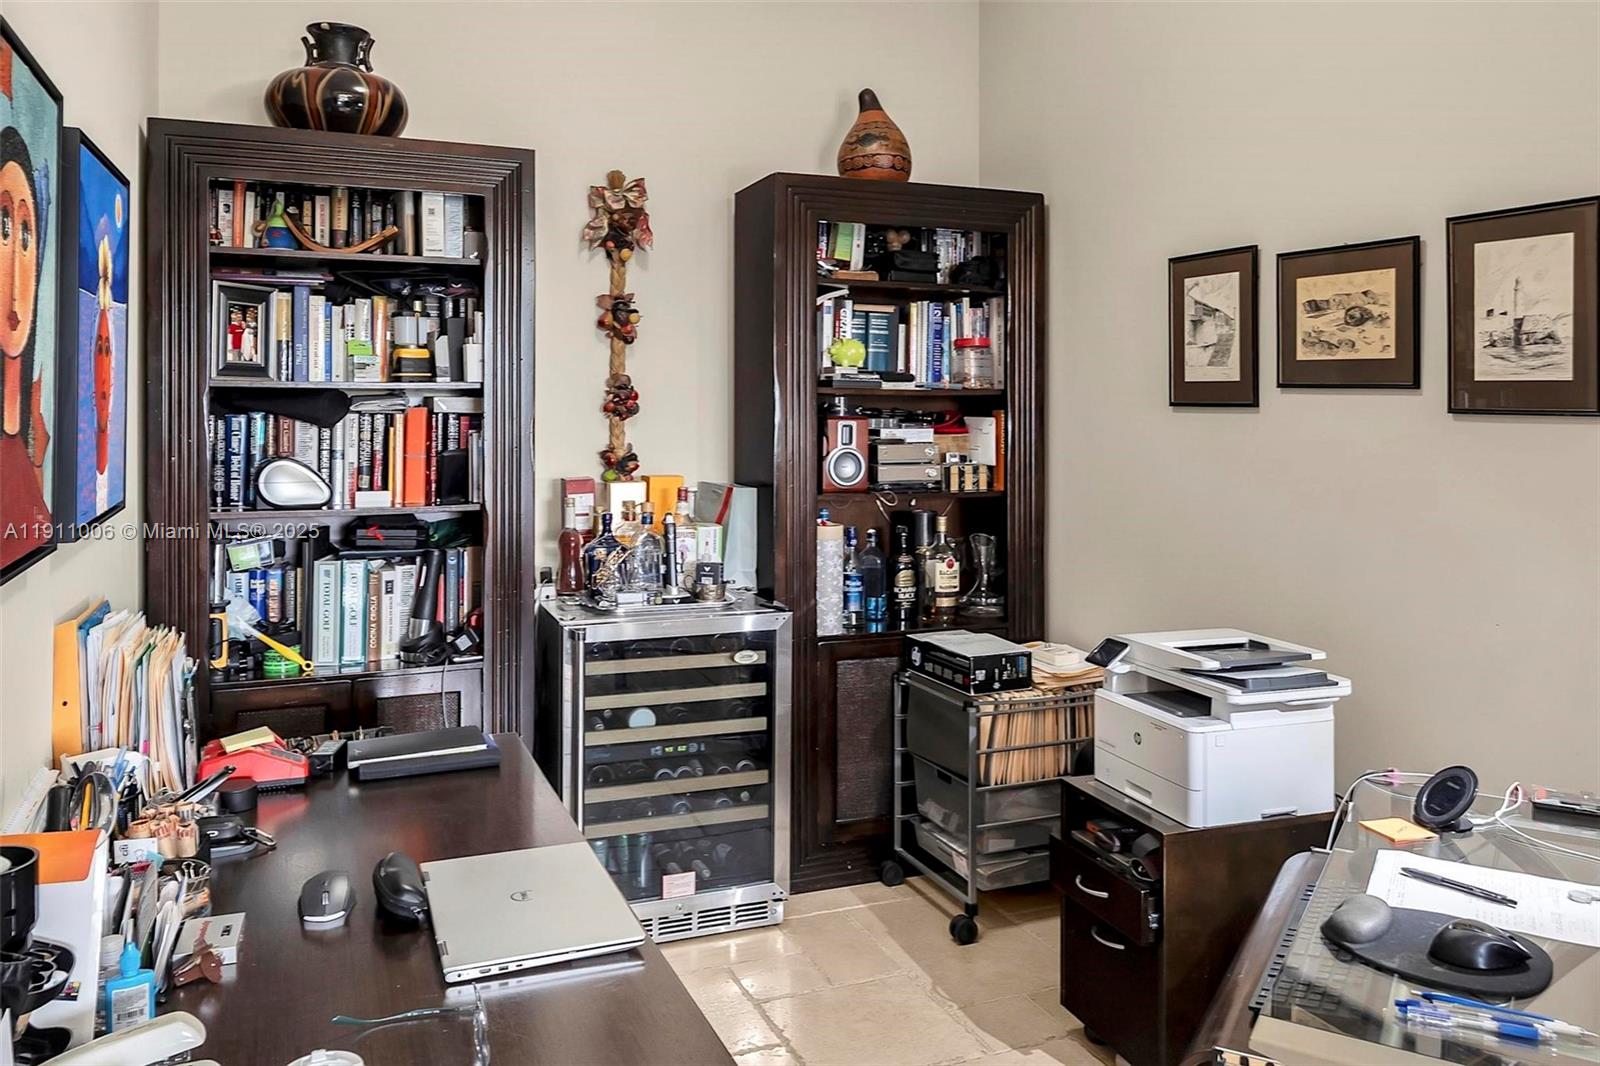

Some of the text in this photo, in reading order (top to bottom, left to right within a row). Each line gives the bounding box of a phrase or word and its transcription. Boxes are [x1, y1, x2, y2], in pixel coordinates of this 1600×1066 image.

[231, 417, 243, 431] Tom
[229, 431, 242, 453] Clancy
[230, 455, 243, 472] Debt
[230, 480, 243, 501] Honor
[323, 582, 331, 632] TOTAL GOLF
[349, 603, 358, 626] GOLF
[119, 844, 129, 857] citi
